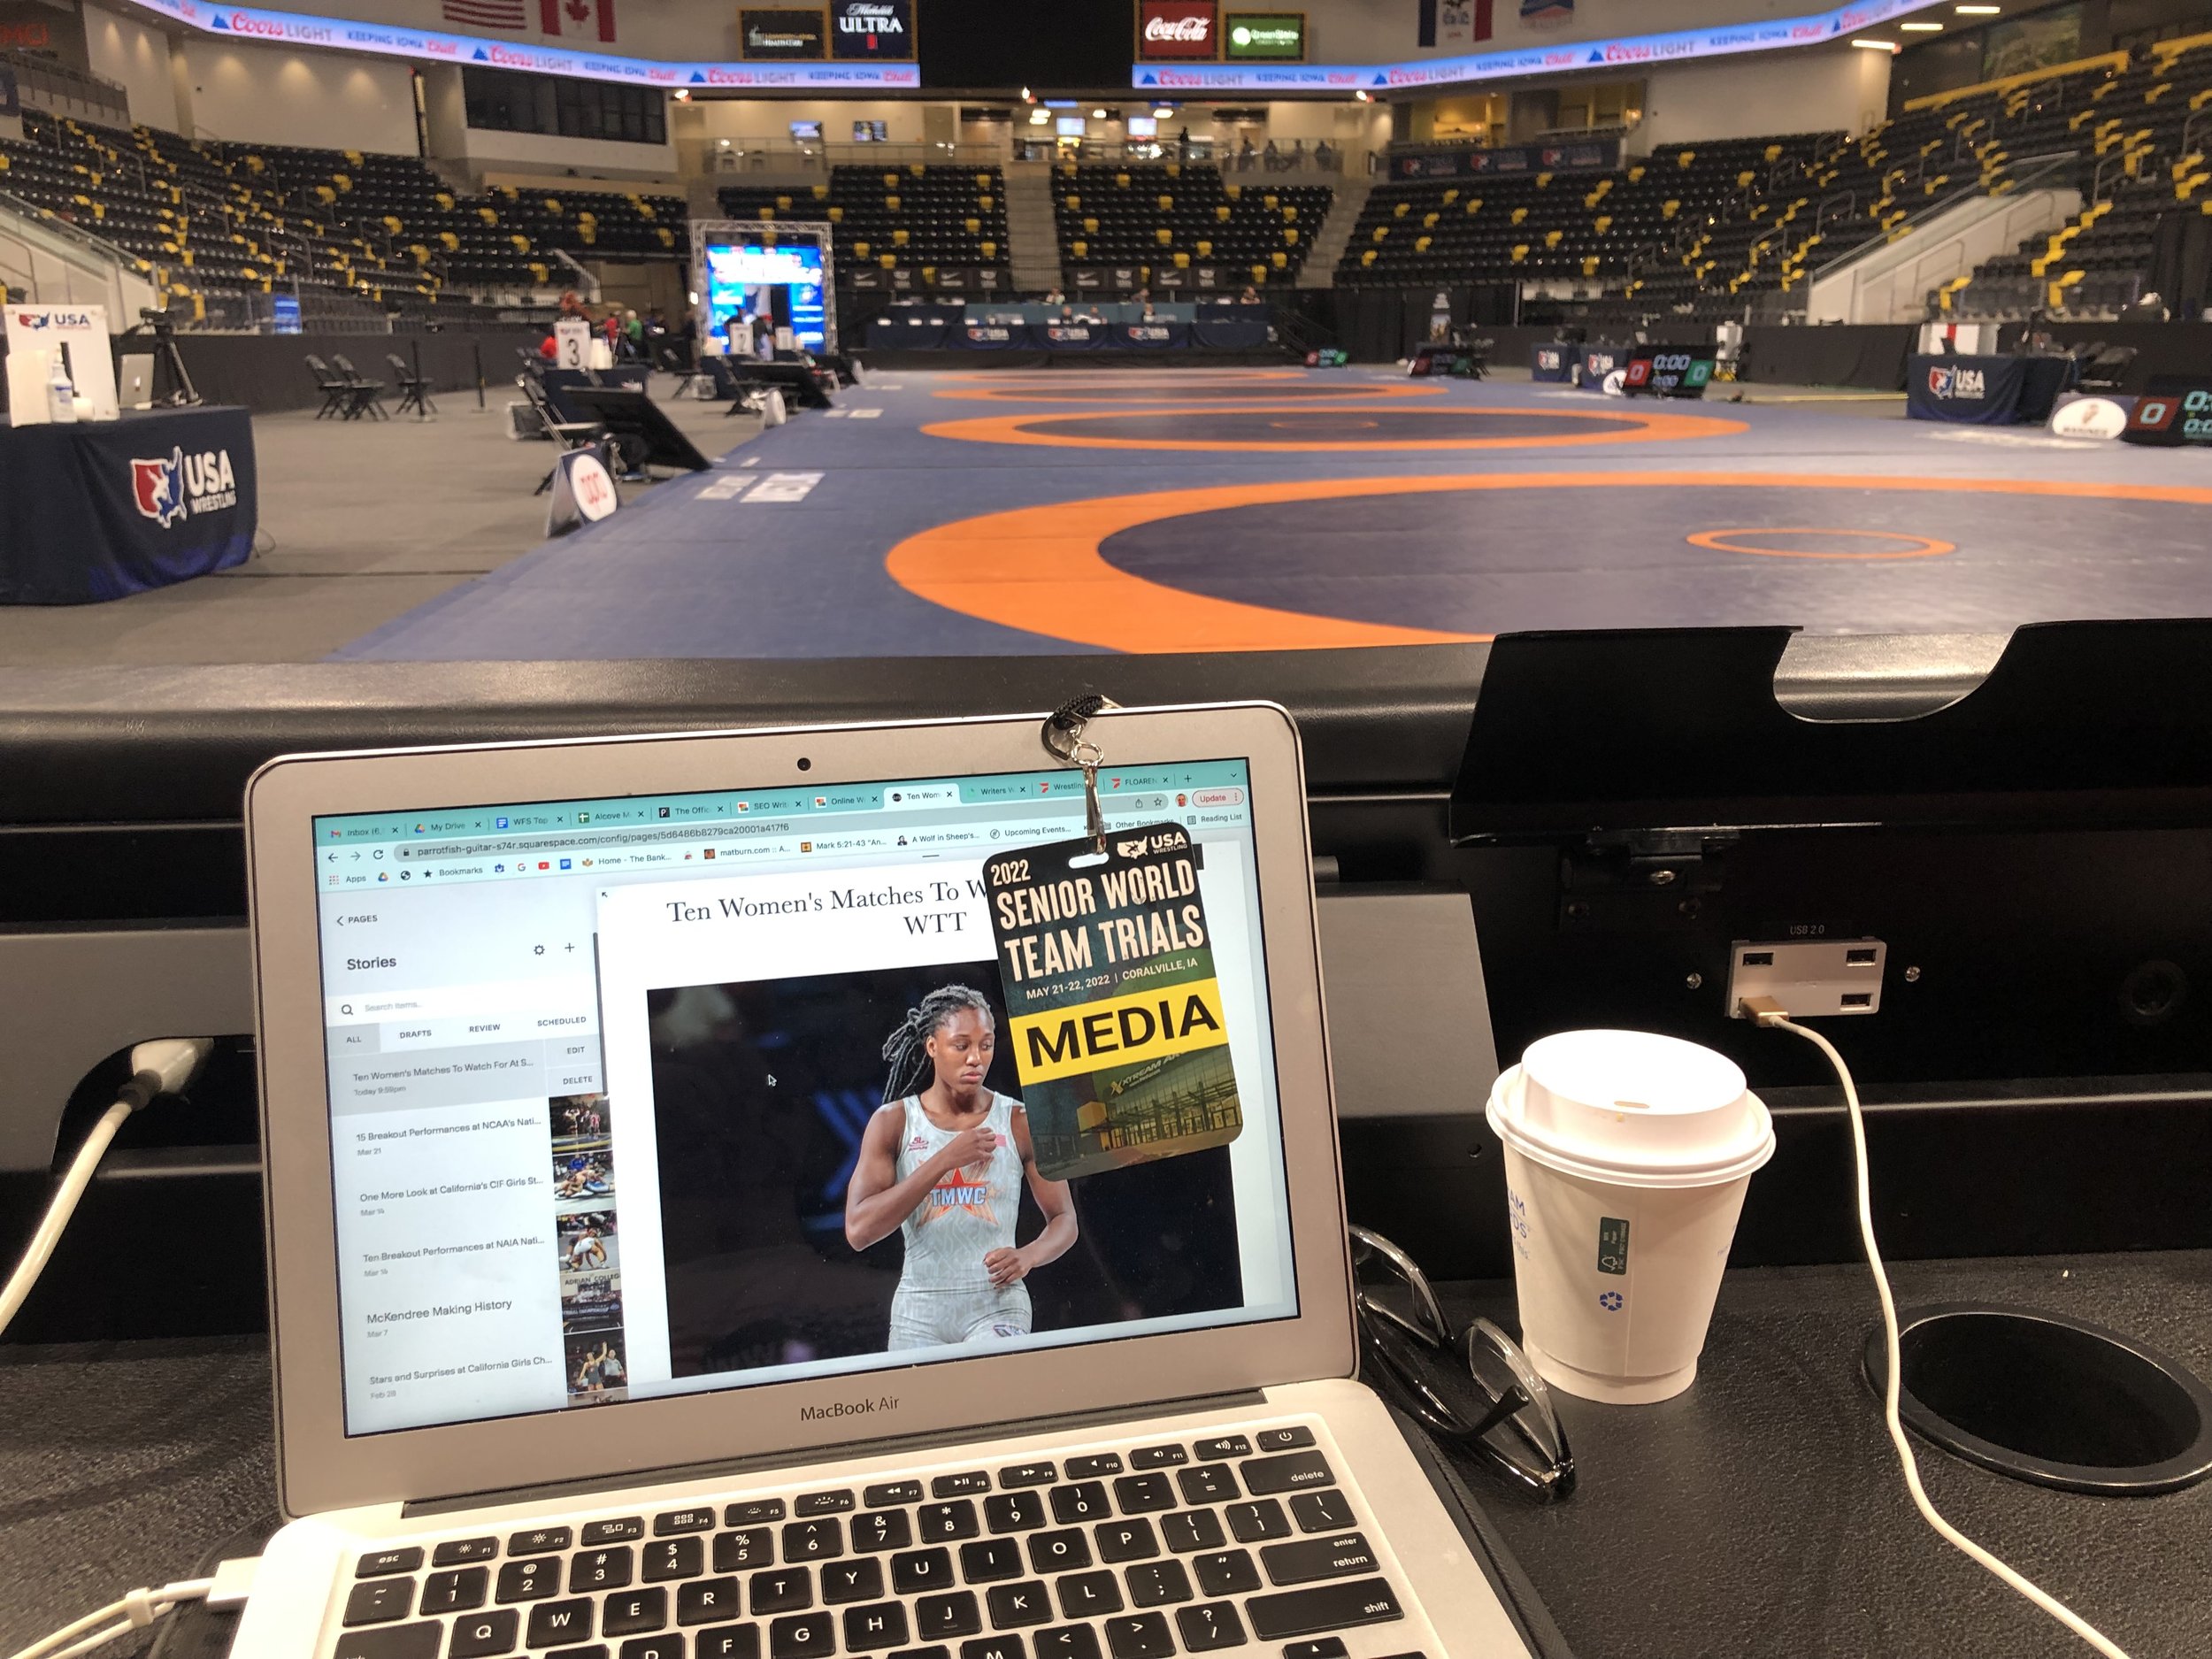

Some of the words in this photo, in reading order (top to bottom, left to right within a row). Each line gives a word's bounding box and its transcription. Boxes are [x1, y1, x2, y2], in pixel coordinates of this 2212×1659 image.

[231, 12, 283, 37] Coors
[287, 20, 332, 42] LIGHT
[839, 16, 904, 33] ULTRA
[1653, 41, 1696, 58] LIGHT
[756, 73, 795, 84] LIGHT
[1204, 74, 1243, 86] LIGHT
[55, 313, 91, 326] USA
[566, 338, 582, 367] 3
[1955, 368, 1985, 390] USA
[2139, 403, 2167, 425] 0
[184, 449, 235, 496] USA
[190, 489, 237, 515] WRESTLING
[980, 787, 1006, 795] Writers
[831, 795, 855, 805] Online
[1200, 794, 1226, 803] Update
[675, 806, 690, 815] The
[754, 802, 770, 810] SEO
[514, 817, 532, 826] WFS
[595, 811, 620, 820] Alcove
[1201, 813, 1230, 824] Reading
[1232, 812, 1242, 822] List
[431, 823, 442, 833] My
[445, 821, 465, 831] Drive
[1116, 819, 1134, 828] Other
[919, 833, 935, 842] Wolf
[1004, 826, 1041, 838] Upcoming
[817, 841, 835, 850] Mark
[837, 839, 865, 849] 5:21-43
[1150, 832, 1186, 849] USA
[720, 846, 771, 856] matburn.com
[1153, 843, 1187, 855] WRESTLING
[598, 856, 621, 865] Home
[630, 854, 645, 863] The
[439, 866, 483, 877] Bookmarks
[990, 859, 1031, 887] 2022
[346, 874, 366, 884] Apps
[996, 878, 1096, 930] SENIOR
[1100, 859, 1195, 908] WORLD
[666, 902, 710, 923] Ten
[718, 892, 823, 919] Women's
[830, 887, 924, 910] Matches
[930, 882, 959, 902] To
[348, 914, 378, 924] PAGES
[904, 911, 968, 935] WTT
[1790, 926, 1808, 935] USB
[1004, 925, 1093, 982] TEAM
[1098, 904, 1204, 964] TRIALS
[347, 956, 396, 971] Stories
[1026, 986, 1050, 1000] MAY
[1052, 980, 1084, 995] 21-22,
[1086, 974, 1110, 988] 2022
[1122, 961, 1186, 980] CORALVILLE,
[1187, 957, 1198, 969] IA
[537, 1017, 587, 1027] SCHEDULED
[399, 1030, 432, 1039] DRAFTS
[469, 1024, 501, 1033] REVIEW
[1025, 994, 1219, 1069] MEDIA
[346, 1035, 362, 1044] ALL
[353, 1073, 369, 1082] Ten
[371, 1069, 411, 1080] Women's
[413, 1066, 450, 1077] Matches
[453, 1064, 463, 1073] To
[465, 1062, 492, 1071] Watch
[494, 1061, 509, 1070] For
[563, 1076, 593, 1085] DELETE
[368, 1130, 407, 1141] Breakout
[409, 1124, 470, 1137] Performances
[482, 1119, 515, 1130] NCAA's
[360, 1193, 379, 1202] One
[381, 1190, 404, 1200] More
[406, 1187, 428, 1197] Look
[440, 1180, 488, 1194] California's
[490, 1179, 505, 1189] CIF
[506, 1177, 526, 1187] Girls
[930, 1187, 987, 1207] TMWC
[364, 1253, 380, 1263] Ten
[381, 1249, 420, 1261] Breakout
[423, 1242, 484, 1256] Performances
[496, 1239, 519, 1249] NAIA
[367, 1309, 430, 1325] McKendree
[433, 1304, 472, 1317] Making
[474, 1300, 512, 1313] History
[370, 1375, 392, 1386] Stars
[395, 1372, 411, 1382] and
[414, 1368, 456, 1381] Surprises
[457, 1366, 466, 1375] at
[467, 1361, 510, 1373] California
[511, 1358, 531, 1369] Girls
[801, 1399, 875, 1421] MacBook
[879, 1396, 900, 1411] Air
[1291, 1470, 1325, 1482] delete
[1121, 1532, 1132, 1544] P
[1333, 1537, 1357, 1548] enter
[379, 1555, 399, 1564] esc
[1333, 1555, 1368, 1567] return
[916, 1561, 929, 1575] U
[1364, 1601, 1389, 1614] shift
[552, 1612, 571, 1627] W
[476, 1624, 492, 1639] Q
